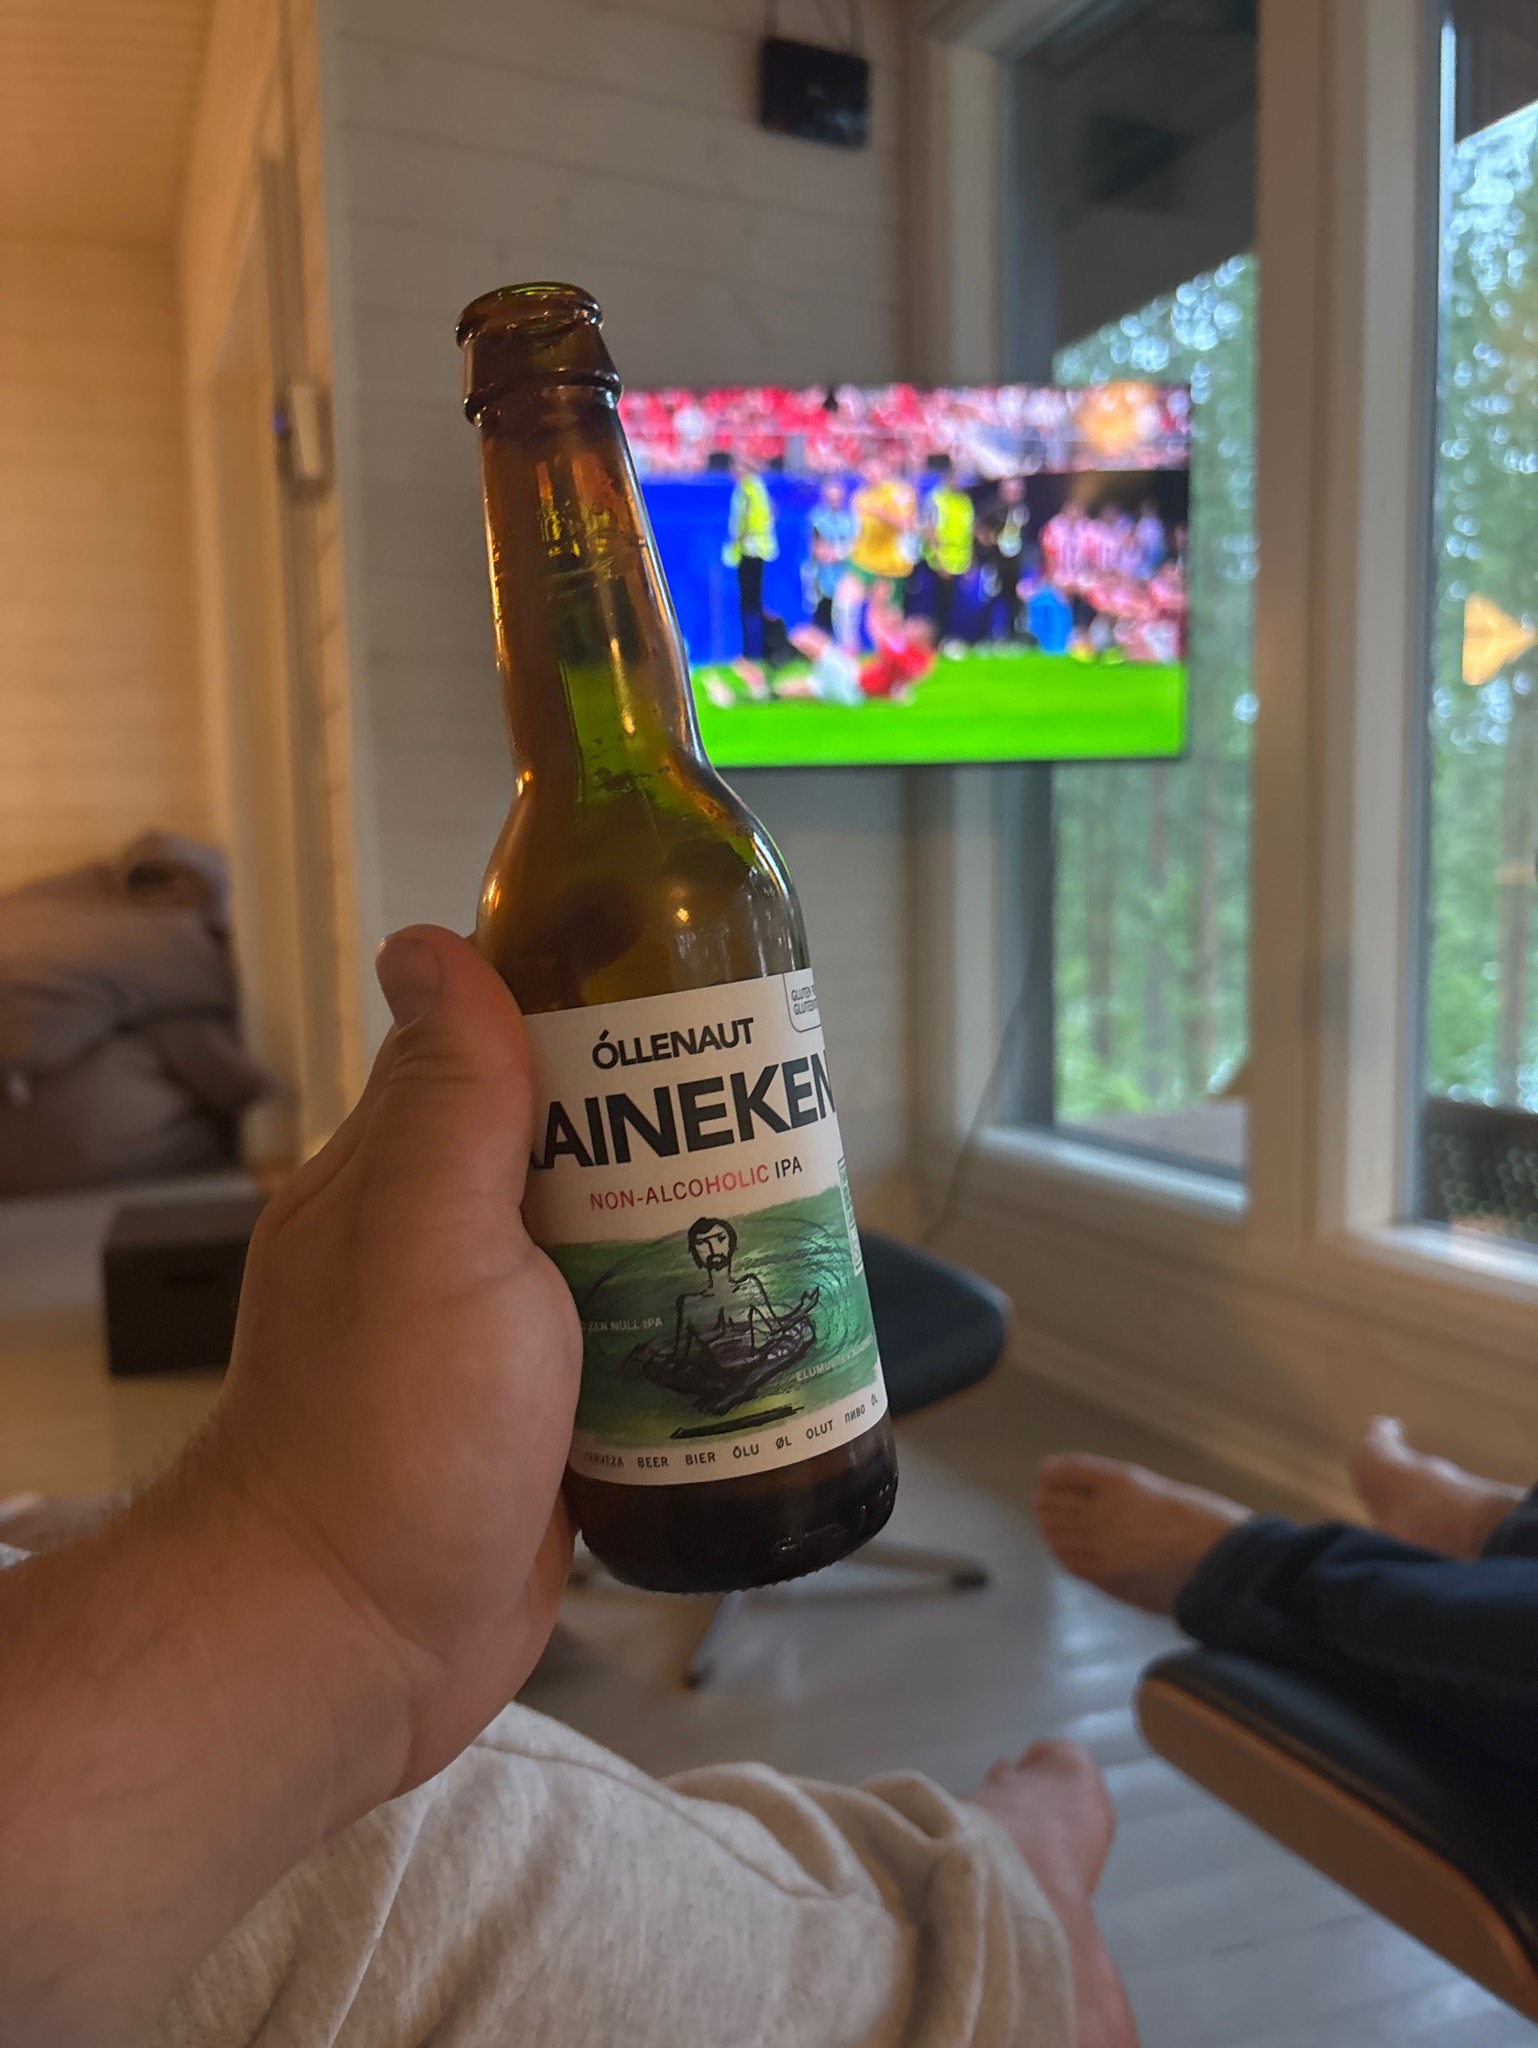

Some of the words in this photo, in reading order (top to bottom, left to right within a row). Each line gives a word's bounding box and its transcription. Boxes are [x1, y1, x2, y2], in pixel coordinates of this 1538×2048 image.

[529, 1050, 836, 1170] AINEKEN
[590, 1164, 770, 1212] NON-ALCOHOLIC
[775, 1156, 803, 1179] IPA
[637, 1455, 669, 1469] BEER
[685, 1451, 716, 1465] BIER
[775, 1435, 792, 1450] ØL
[806, 1419, 834, 1440] OLUT
